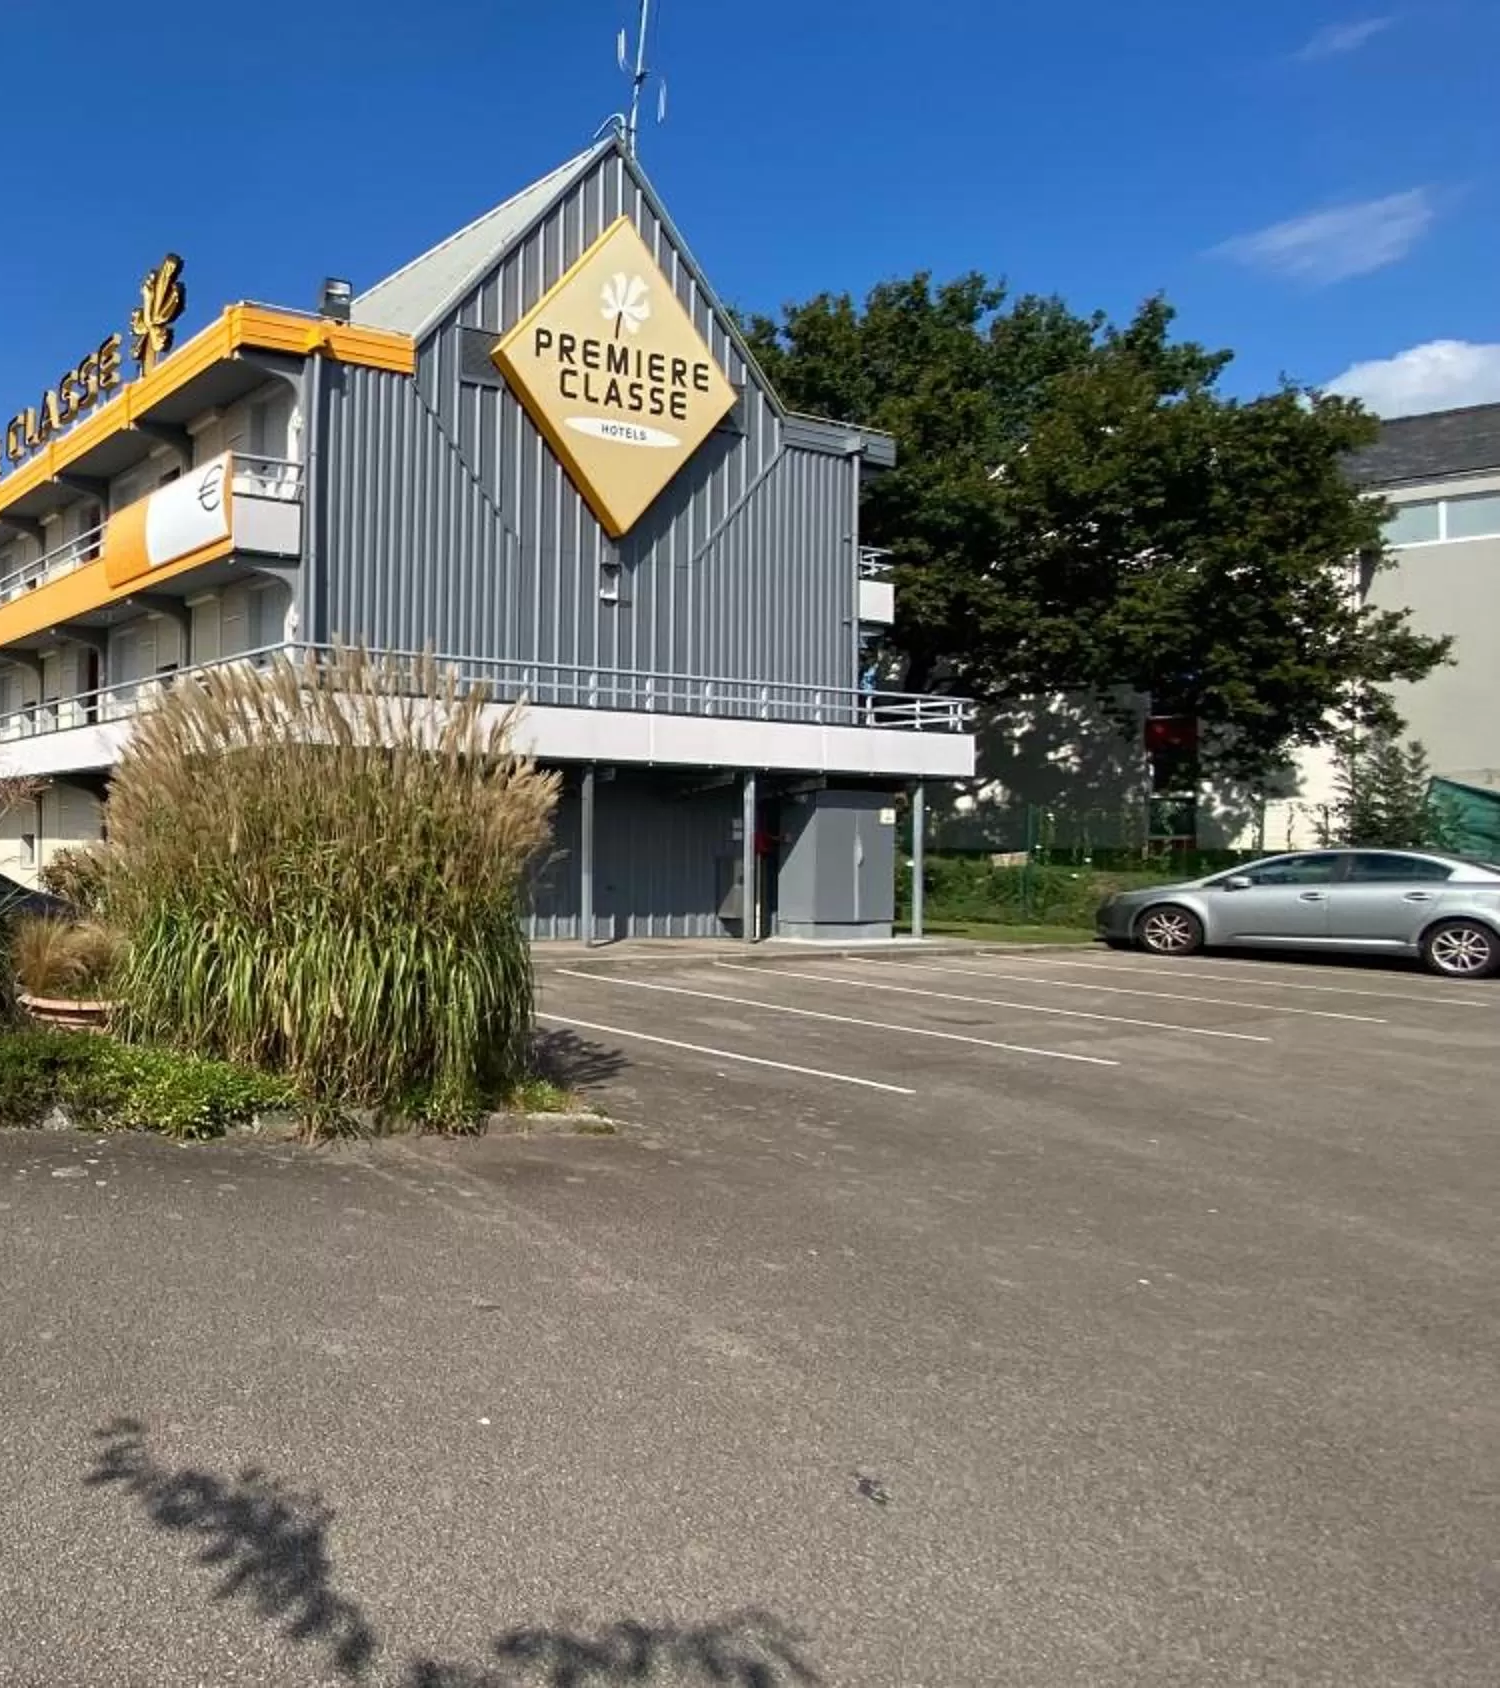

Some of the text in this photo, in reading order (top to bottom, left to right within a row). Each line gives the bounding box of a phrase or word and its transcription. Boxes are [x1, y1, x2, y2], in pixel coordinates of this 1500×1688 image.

[535, 327, 709, 392] PREMIERE
[6, 333, 121, 460] CLASSE
[559, 368, 687, 420] CLASSE
[601, 423, 647, 441] HOTELS
